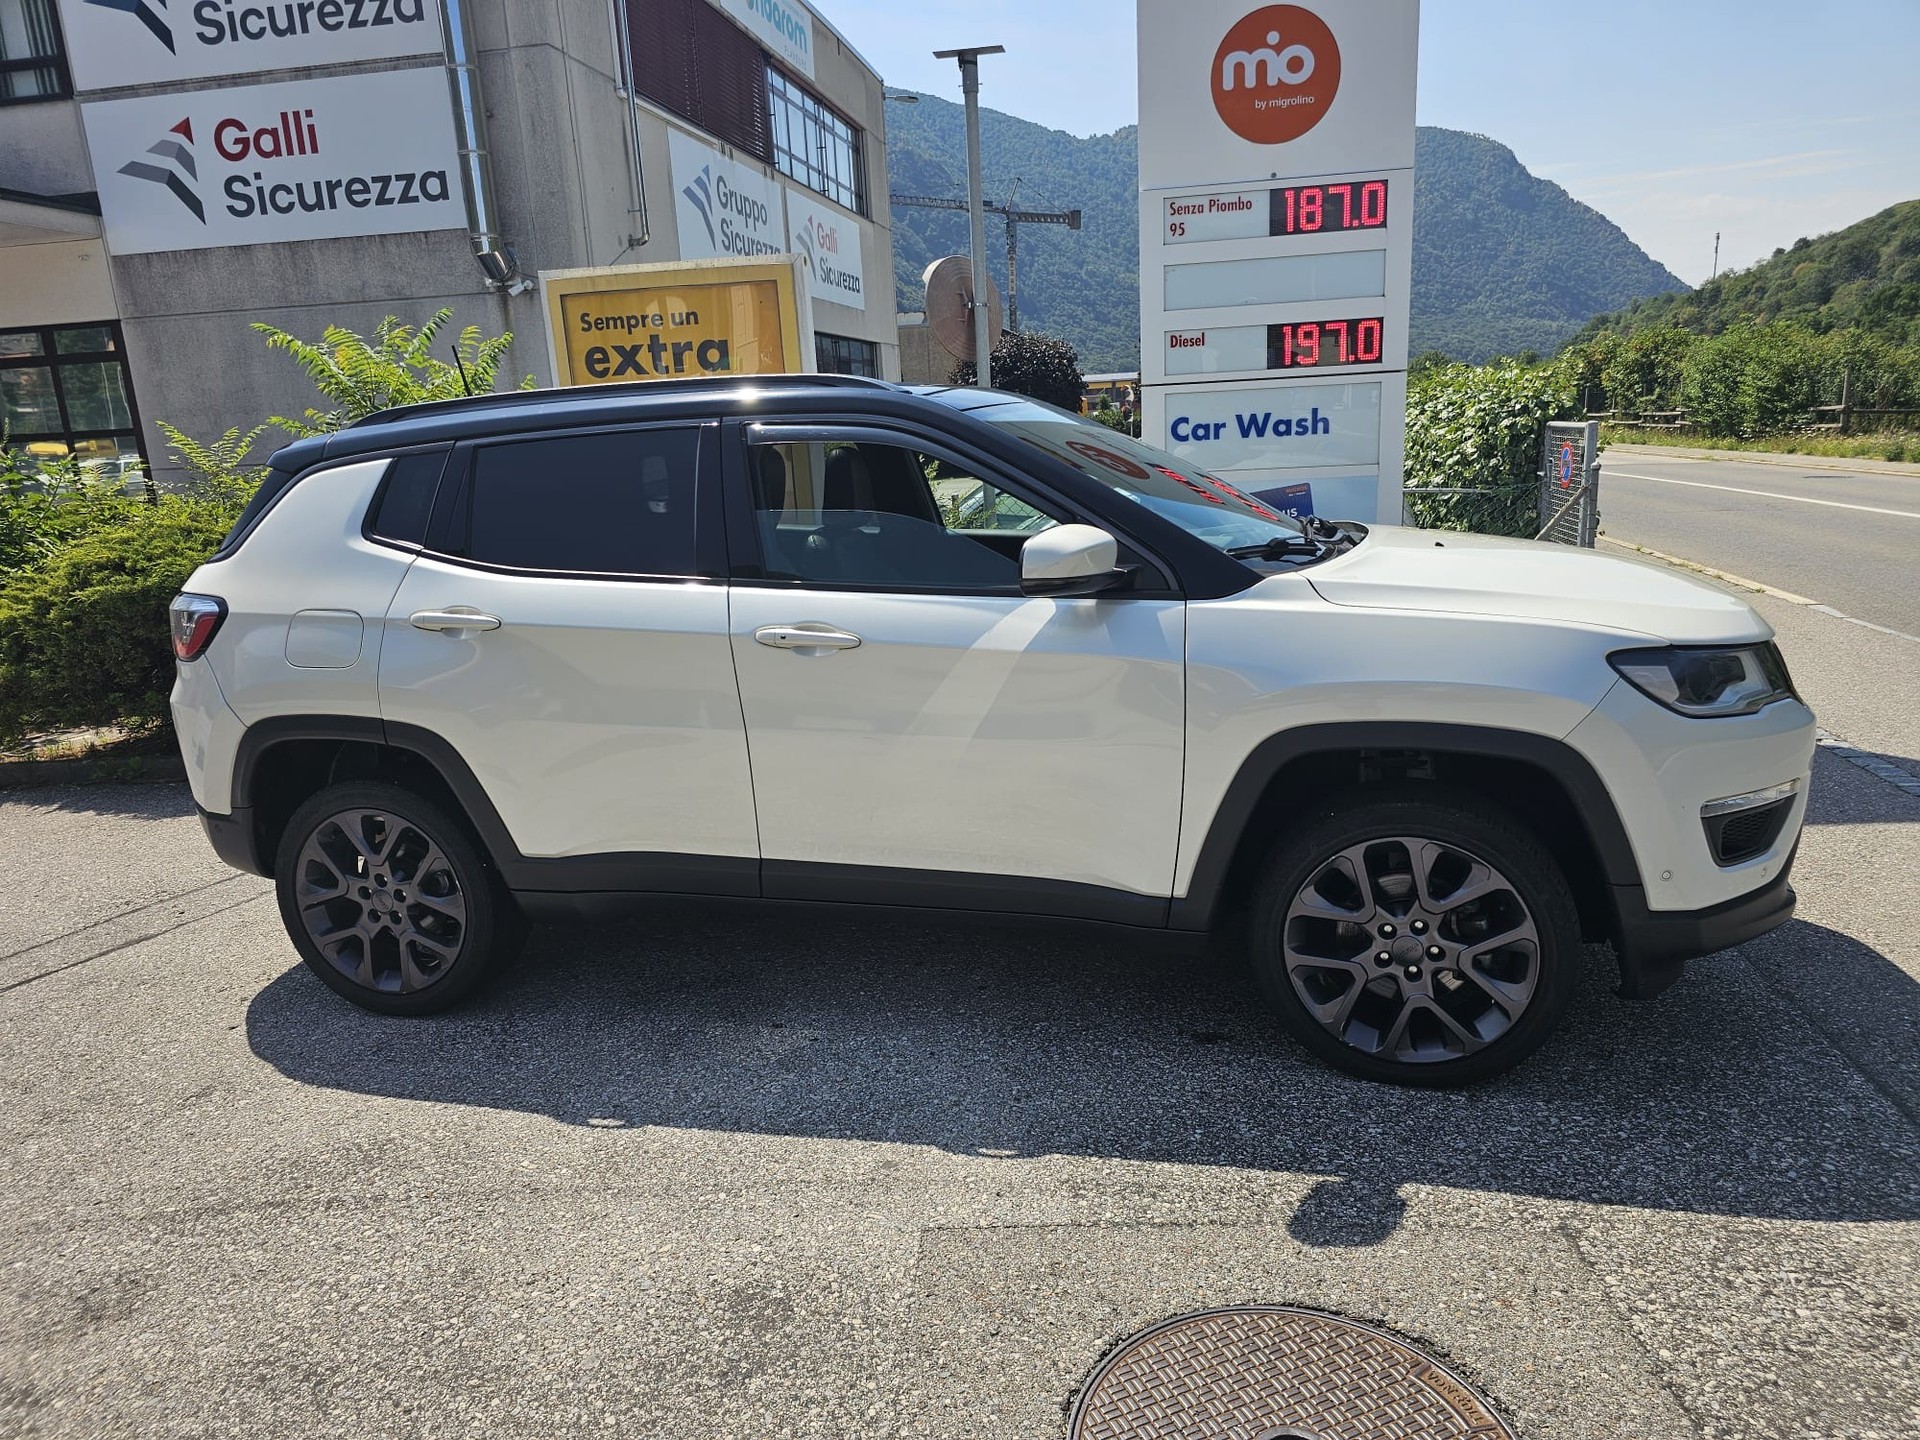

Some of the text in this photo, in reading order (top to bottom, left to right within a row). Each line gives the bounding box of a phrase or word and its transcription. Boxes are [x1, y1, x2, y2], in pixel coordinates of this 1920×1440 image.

[193, 0, 425, 45] Sicurezza
[1222, 31, 1315, 90] mio
[1255, 95, 1315, 109] by migrolino
[213, 109, 320, 161] Galli
[224, 170, 450, 218] Sicurezza
[716, 175, 768, 232] Gruppo
[1170, 196, 1253, 216] Senza Piombo
[1284, 181, 1386, 232] 187.0
[817, 222, 838, 254] Galli
[1170, 223, 1185, 236] 95
[819, 256, 861, 294] Sicurezza
[580, 310, 699, 334] Sempre un
[1170, 332, 1205, 348] Diesel
[1282, 319, 1380, 365] 197.0
[584, 334, 731, 378] extra
[1170, 407, 1330, 442] Car Wash
